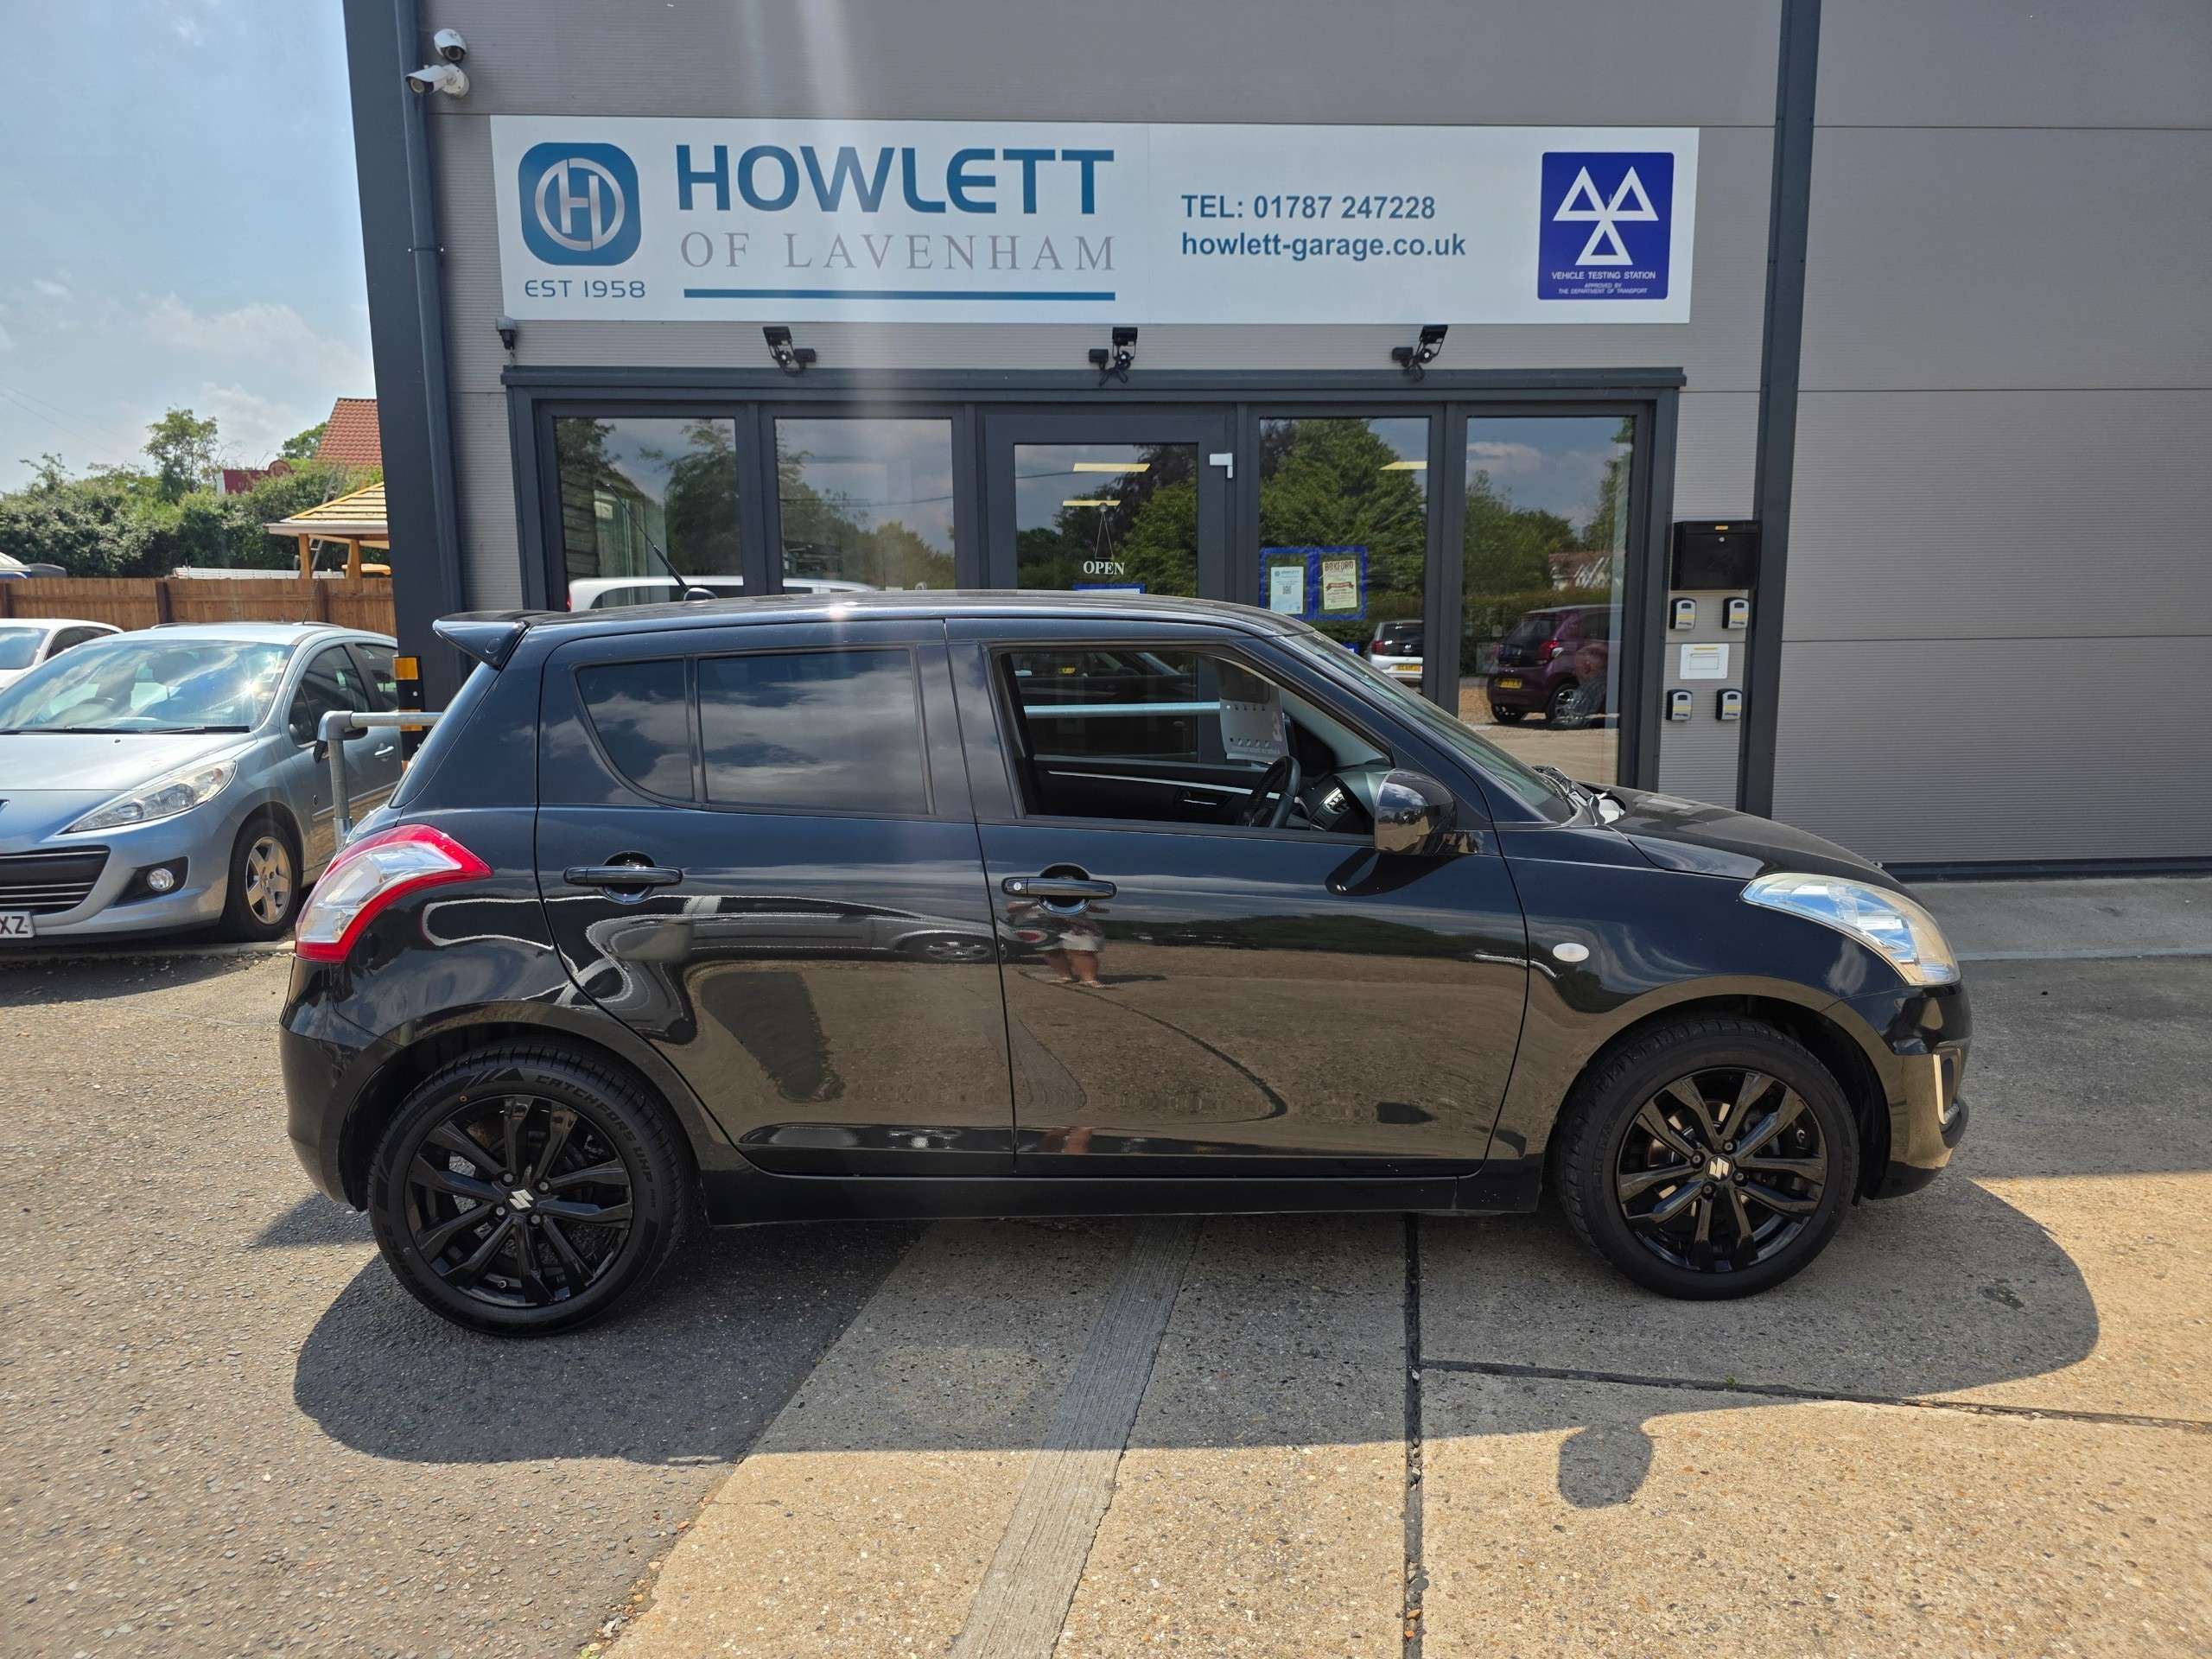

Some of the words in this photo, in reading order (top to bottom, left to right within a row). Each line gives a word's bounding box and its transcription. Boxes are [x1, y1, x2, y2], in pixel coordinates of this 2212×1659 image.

[676, 144, 1115, 215] HOWLETT
[1180, 194, 1243, 219] TEL:
[1254, 194, 1332, 219] 01787
[1341, 195, 1435, 219] 247228
[680, 231, 750, 268] OF
[783, 232, 1116, 271] LAVENHAM
[1182, 232, 1466, 261] howlett-garage.co.uk
[524, 279, 573, 298] EST
[584, 280, 646, 299] 1958
[1551, 271, 1585, 280] VEHICLE
[1588, 271, 1621, 280] TESTING
[1624, 271, 1656, 280] STATION
[1083, 561, 1125, 575] OPEN
[534, 1074, 637, 1141] CATCHFORS
[632, 1146, 653, 1183] UHP
